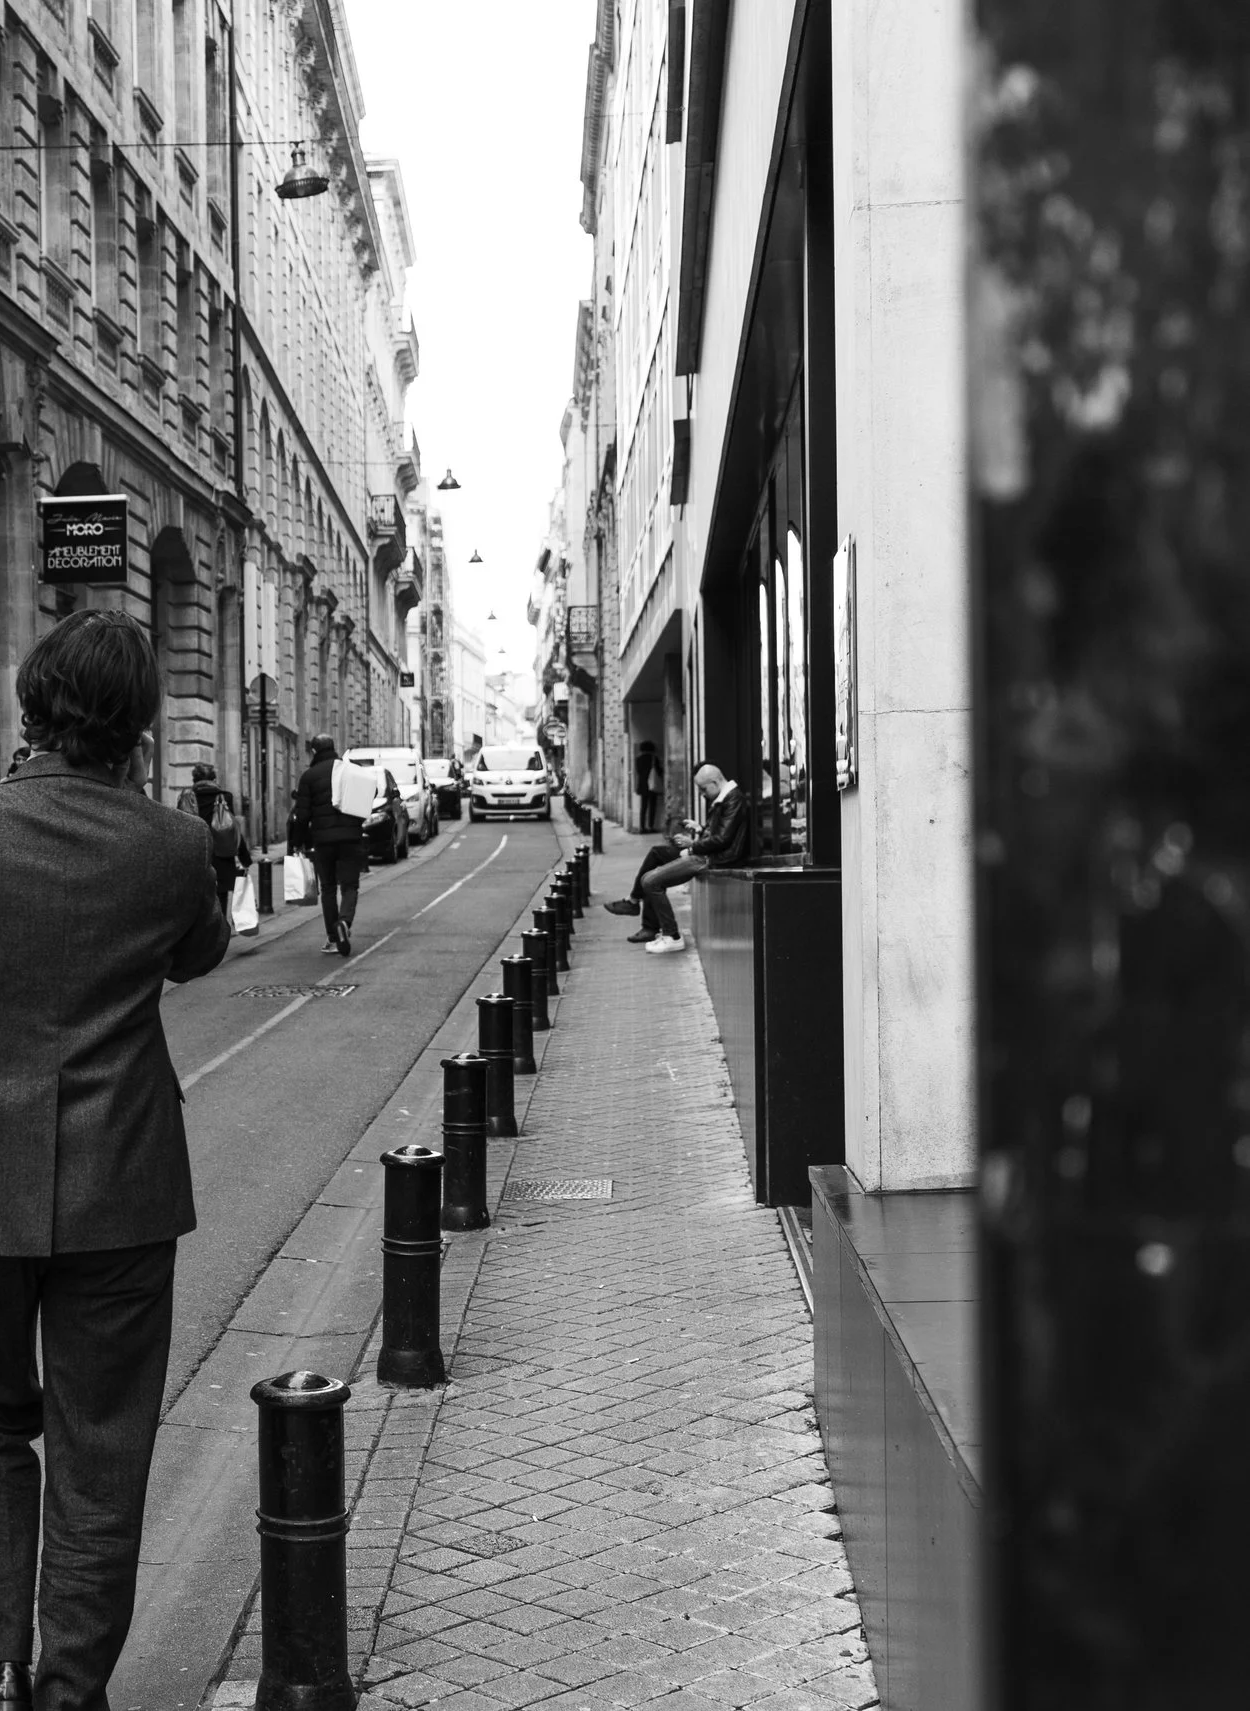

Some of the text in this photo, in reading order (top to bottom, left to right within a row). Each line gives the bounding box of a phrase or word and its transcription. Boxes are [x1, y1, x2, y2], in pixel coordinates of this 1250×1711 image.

[66, 523, 104, 536] MORO
[48, 544, 121, 557] AMEUBLEMENT
[47, 556, 122, 569] DECORATION
